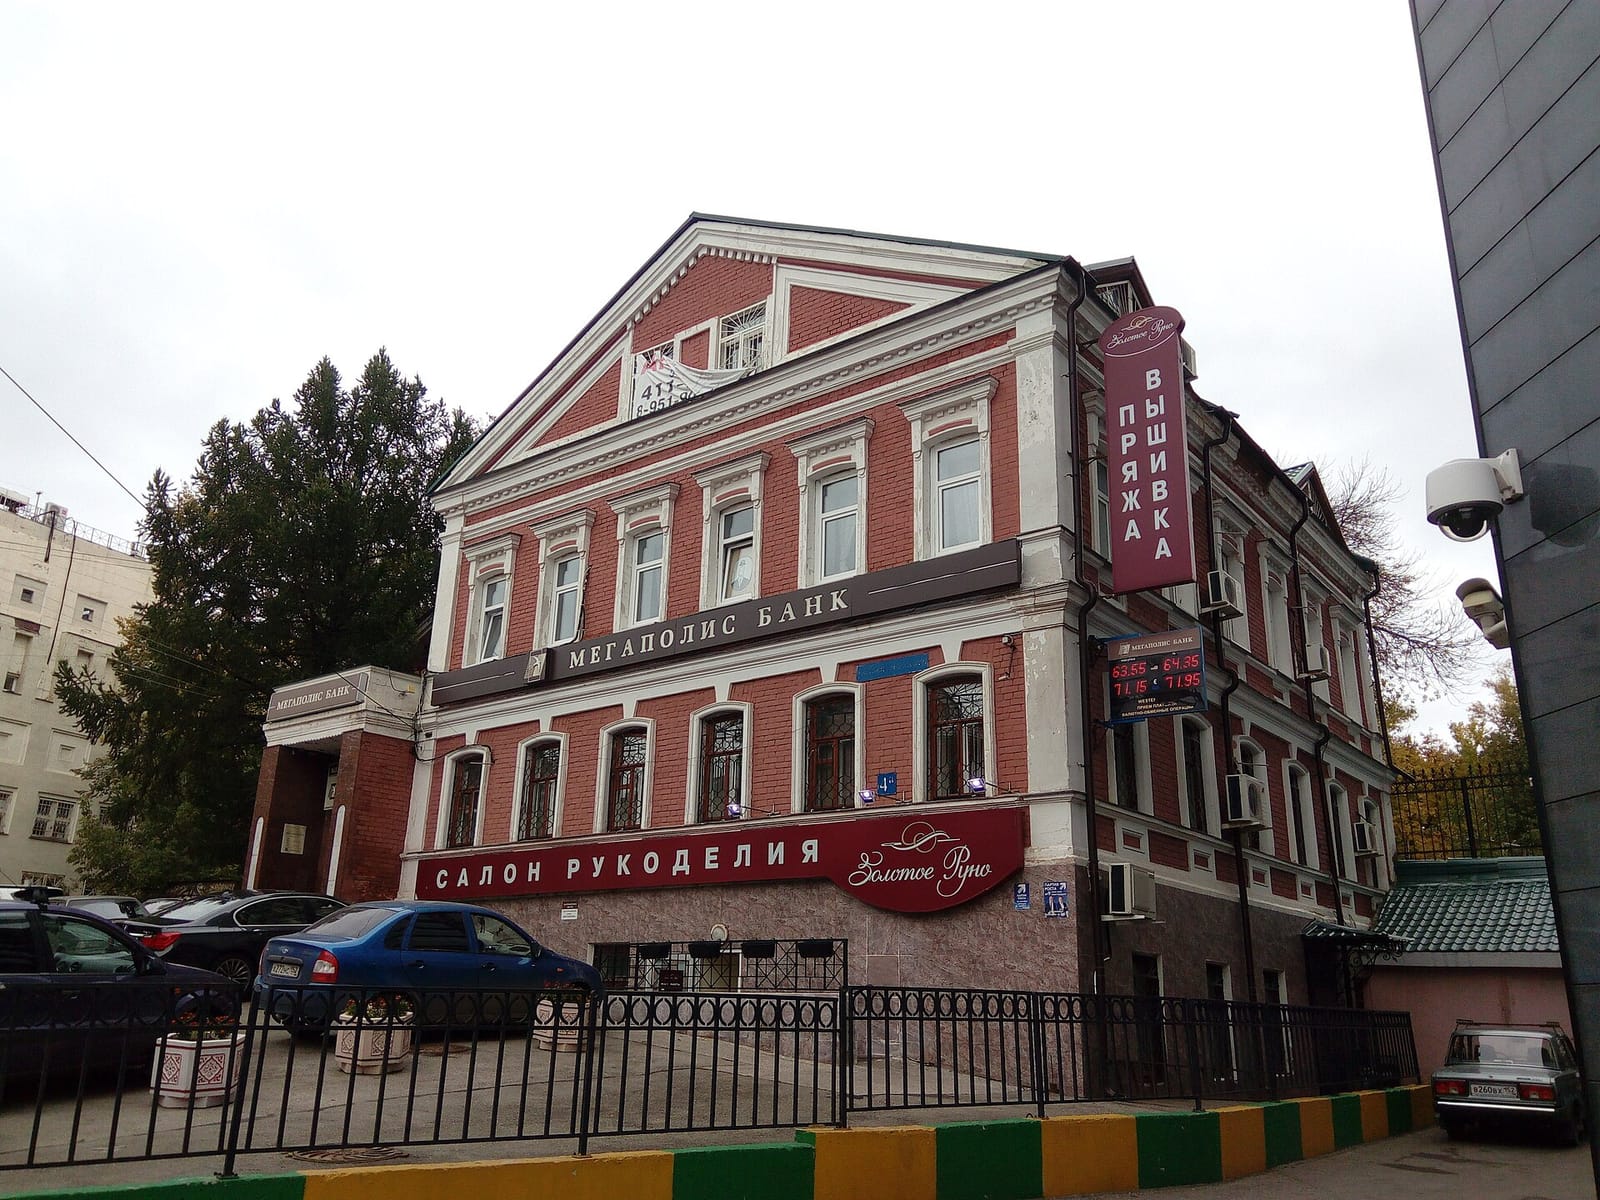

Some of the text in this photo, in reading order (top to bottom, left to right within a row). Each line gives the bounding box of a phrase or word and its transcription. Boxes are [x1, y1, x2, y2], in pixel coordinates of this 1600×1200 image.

[1107, 319, 1174, 349] Золотое Руно
[1119, 404, 1142, 542] ПРЯЖА
[1145, 368, 1173, 560] ВЫШИВКА
[568, 588, 849, 670] МЕГАПОЛИС БАНК
[1131, 636, 1193, 651] МЕГАПОЛИС БАНК
[1112, 654, 1200, 679] 63.55 64.35
[1113, 672, 1201, 697] 71.15 71.95
[276, 685, 350, 711] МЕГАПОЛИС БАНК
[436, 839, 819, 889] САЛОН РУКОДЕЛИЯ
[848, 844, 992, 897] Золотое Руно
